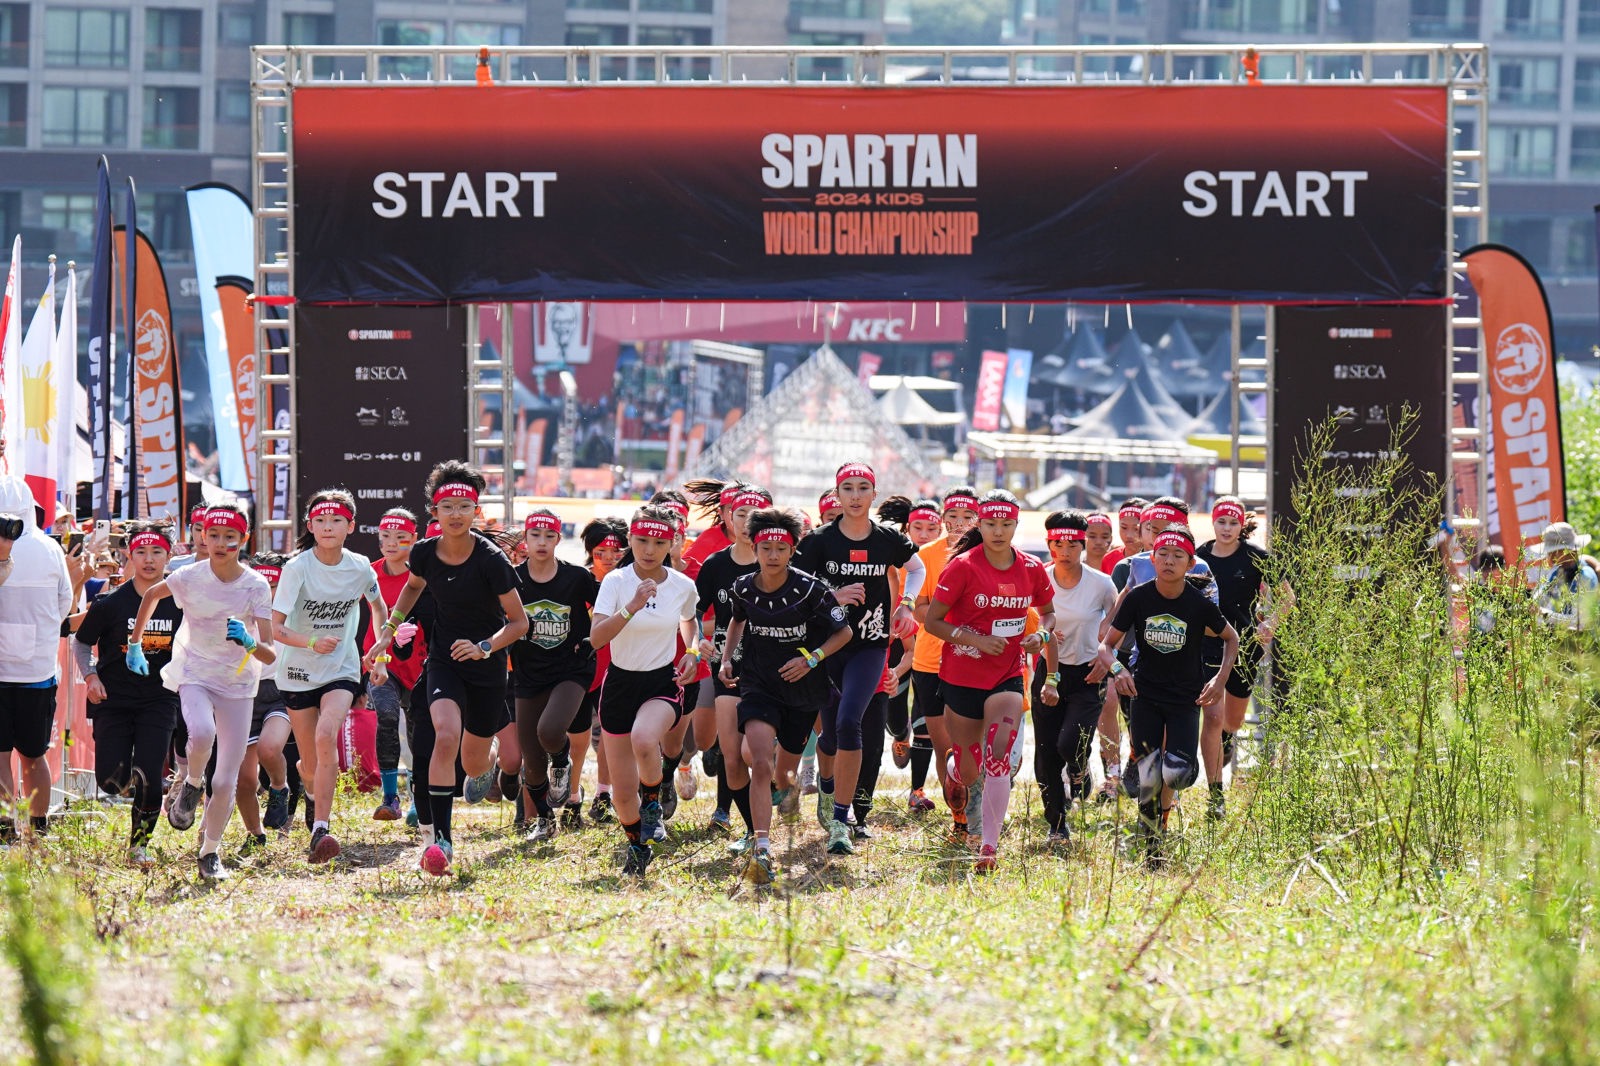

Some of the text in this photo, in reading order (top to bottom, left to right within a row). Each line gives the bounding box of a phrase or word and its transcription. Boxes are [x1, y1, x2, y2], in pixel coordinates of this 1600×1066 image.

[761, 133, 978, 188] SPARTAN
[372, 172, 557, 219] START
[815, 193, 924, 205] 2024 KIDS
[1182, 170, 1368, 218] START
[763, 211, 979, 255] WORLD CHAMPIONSHIP
[847, 318, 905, 341] KFC
[370, 366, 408, 380] SECA
[1349, 365, 1387, 379] SECA
[139, 381, 180, 520] SPAR
[1501, 397, 1552, 560] SPAR
[445, 483, 473, 492] SPARTAN
[742, 494, 764, 502] SPARTAN
[315, 502, 340, 510] SPARTAN
[988, 505, 1012, 513] SPARTAN
[1152, 507, 1175, 515] SPARTAN
[209, 511, 234, 519] SPARTAN
[533, 516, 555, 524] SPARTAN
[643, 522, 669, 532] SPARTAN
[648, 529, 662, 537] 477
[136, 534, 159, 543] SPARTAN
[1162, 533, 1184, 542] SPARTAN
[841, 563, 886, 576] SPARTAN
[128, 618, 173, 631] SRTAN
[533, 621, 569, 636] ONGLI
[1145, 631, 1185, 644] CHONGLI
